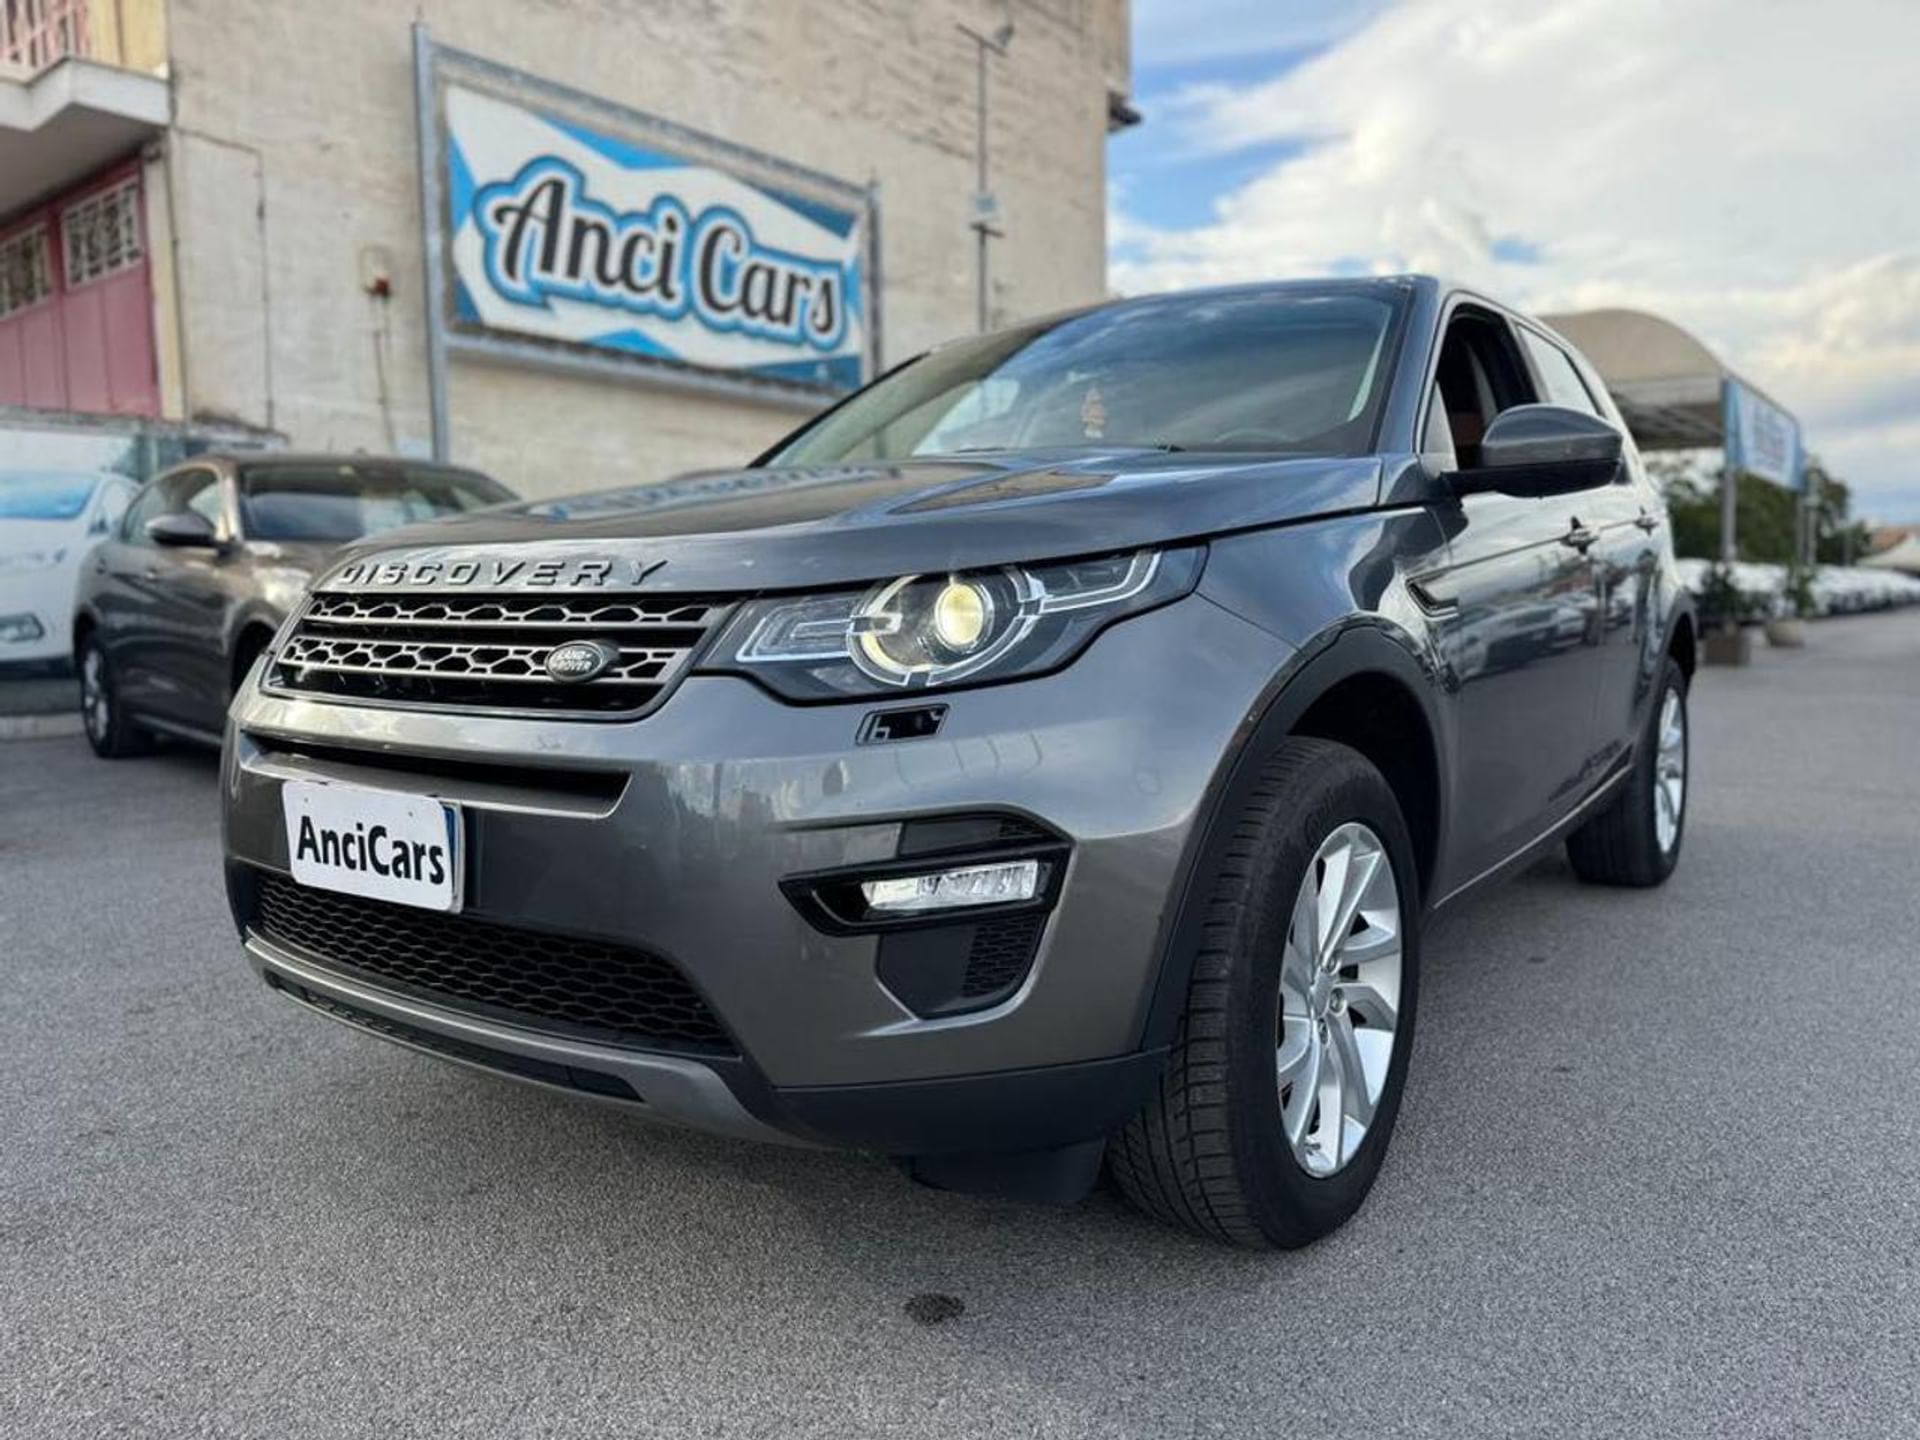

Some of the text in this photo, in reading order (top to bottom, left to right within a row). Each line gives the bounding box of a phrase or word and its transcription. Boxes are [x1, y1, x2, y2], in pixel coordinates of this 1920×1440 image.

[494, 176, 835, 333] Anci Cars
[336, 559, 668, 587] DISCOVERY
[297, 815, 445, 885] AnciCars
